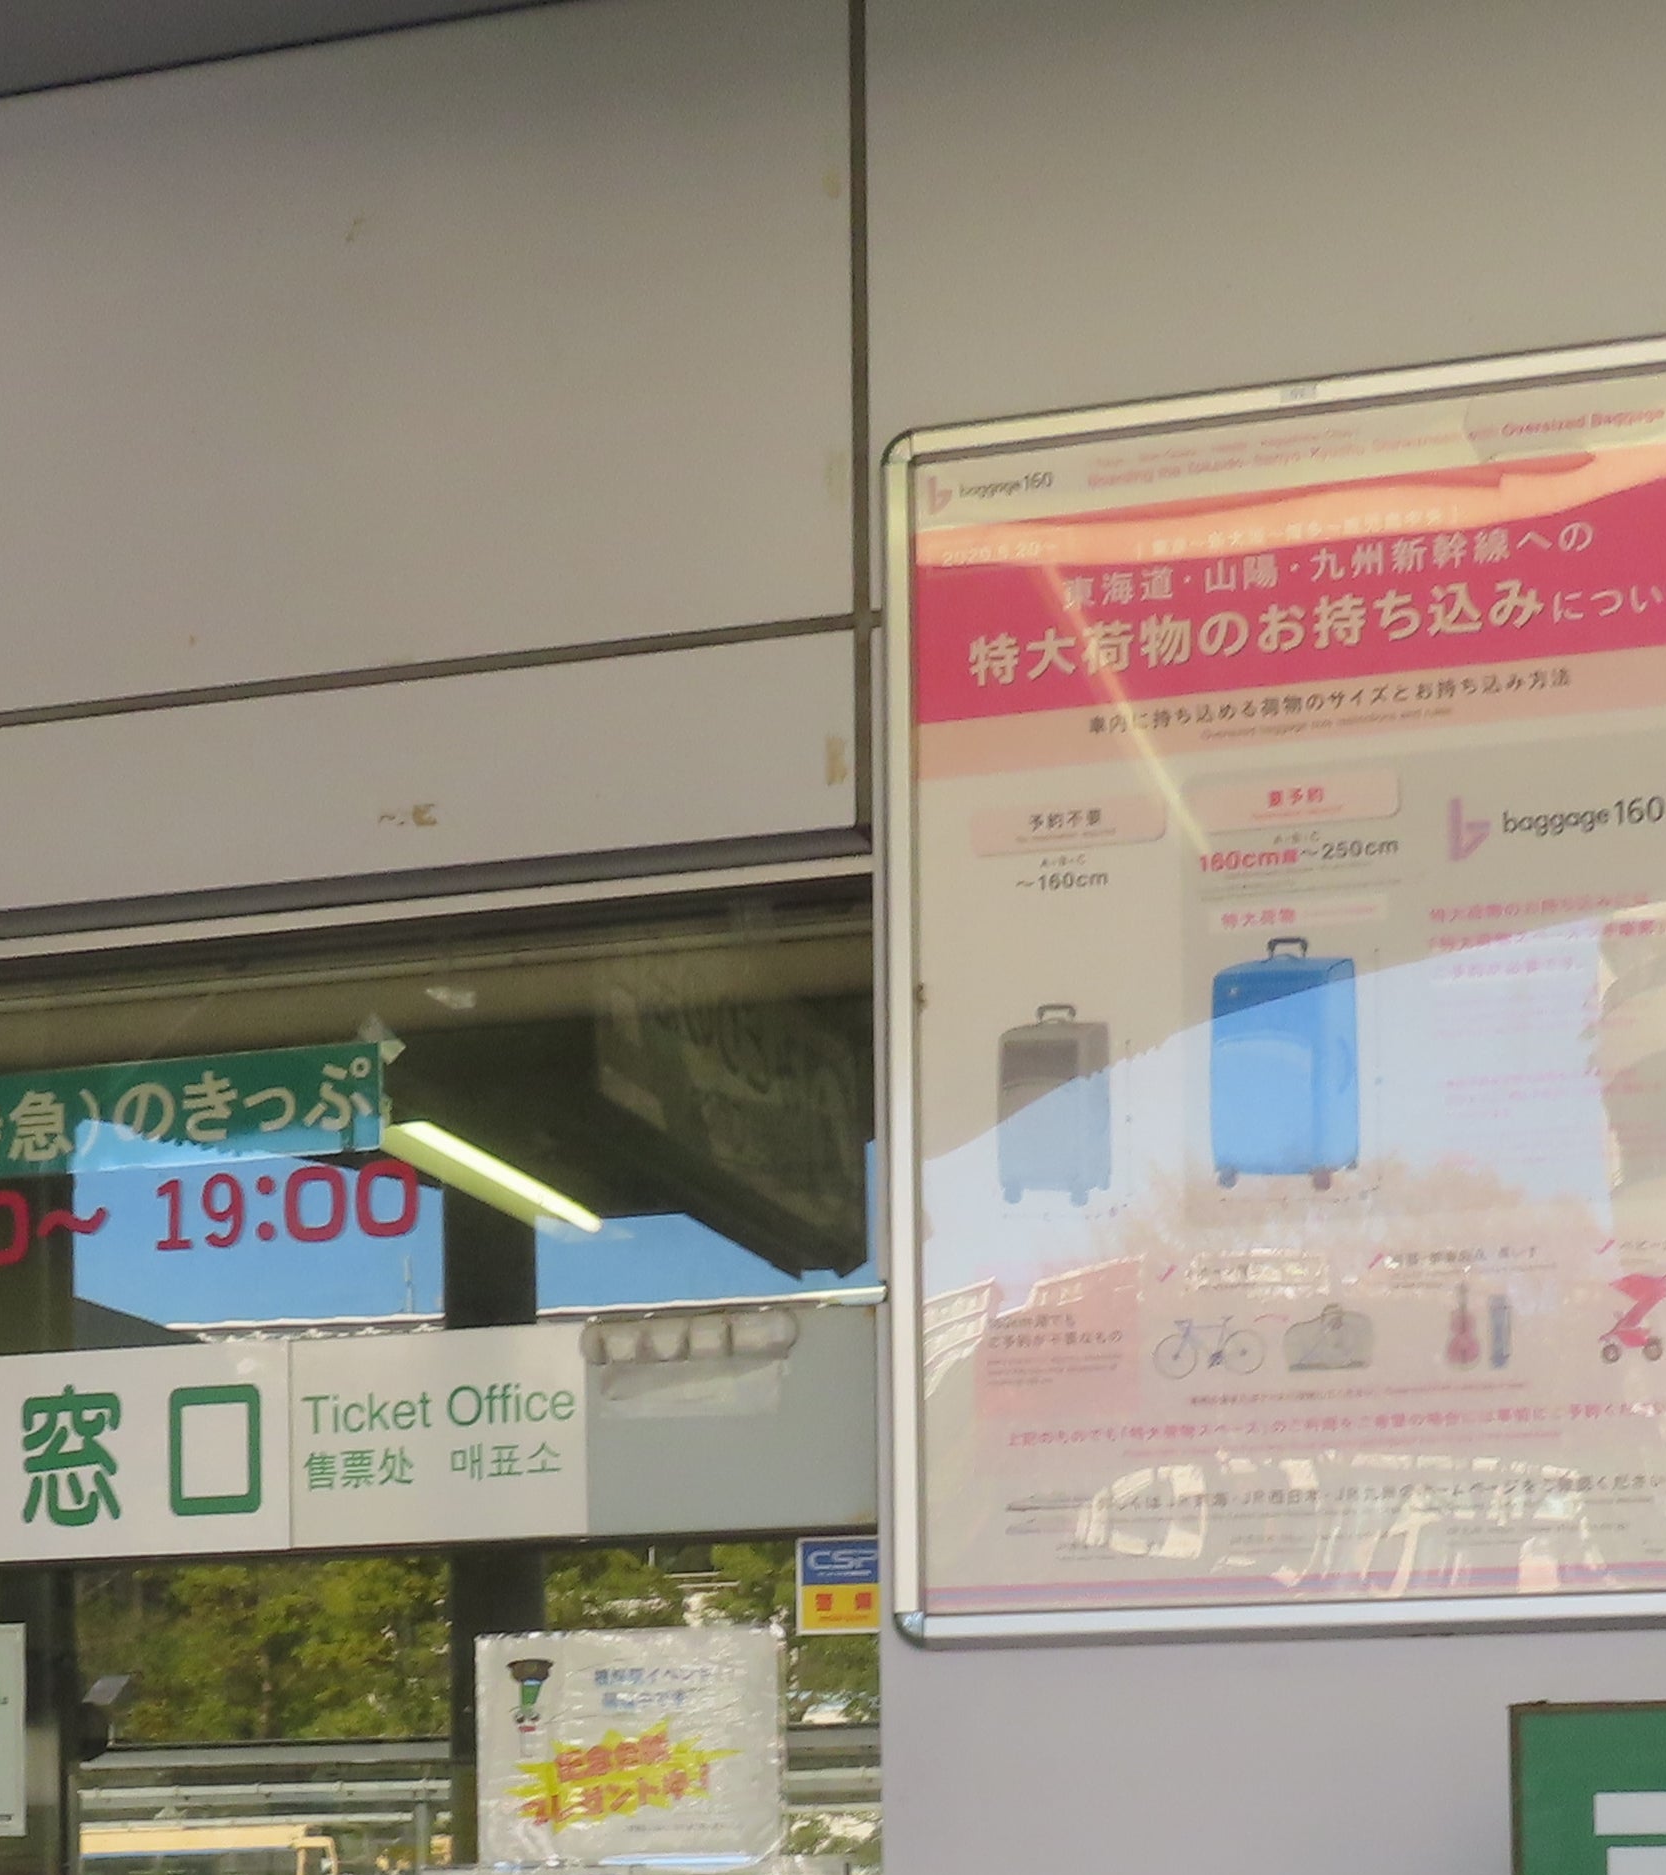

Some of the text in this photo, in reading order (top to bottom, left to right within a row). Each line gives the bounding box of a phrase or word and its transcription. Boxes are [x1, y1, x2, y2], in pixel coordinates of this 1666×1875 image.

[1590, 407, 1666, 427] Baggage
[1064, 521, 1594, 610] 東海道・山陽・九州新幹線への
[1501, 795, 1666, 837] baggage160
[155, 1158, 421, 1254] 19:00
[302, 1381, 577, 1435] Ticket Office
[302, 1447, 415, 1492] 售票处
[450, 1441, 563, 1482] 매표소
